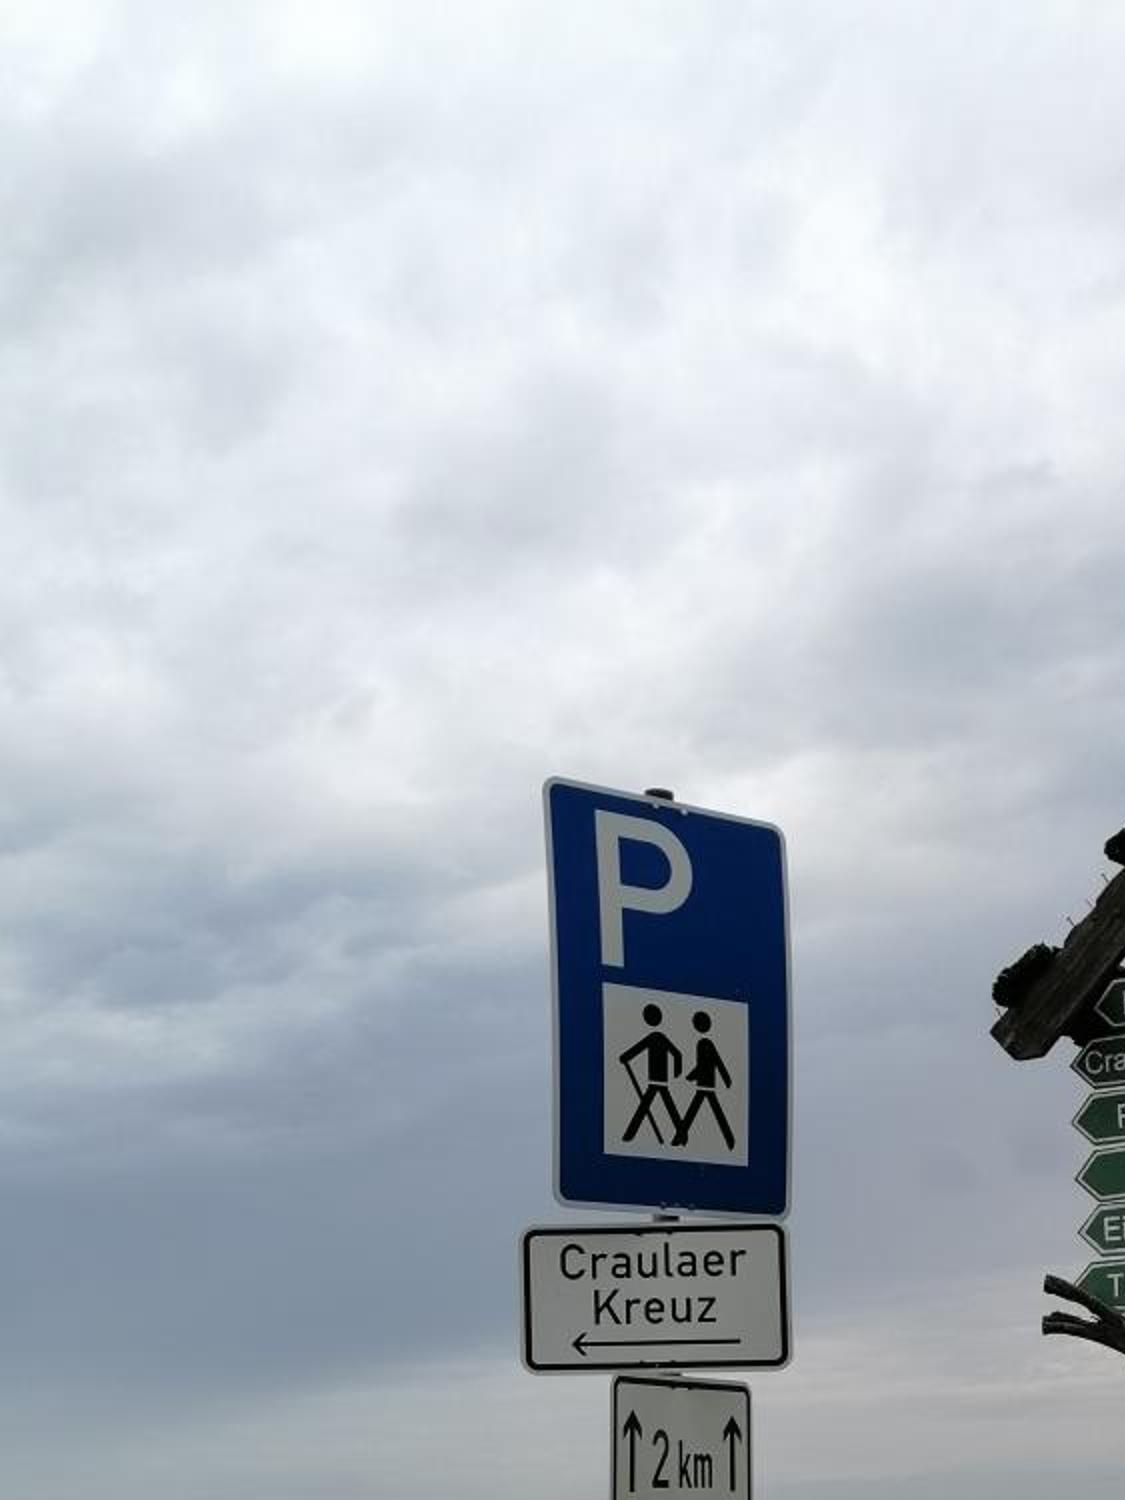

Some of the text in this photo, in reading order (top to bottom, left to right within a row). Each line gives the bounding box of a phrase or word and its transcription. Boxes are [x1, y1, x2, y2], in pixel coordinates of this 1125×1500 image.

[595, 809, 693, 968] P
[559, 1241, 747, 1280] Craulaer
[592, 1288, 717, 1326] Kreuz
[651, 1428, 714, 1489] 2 km
